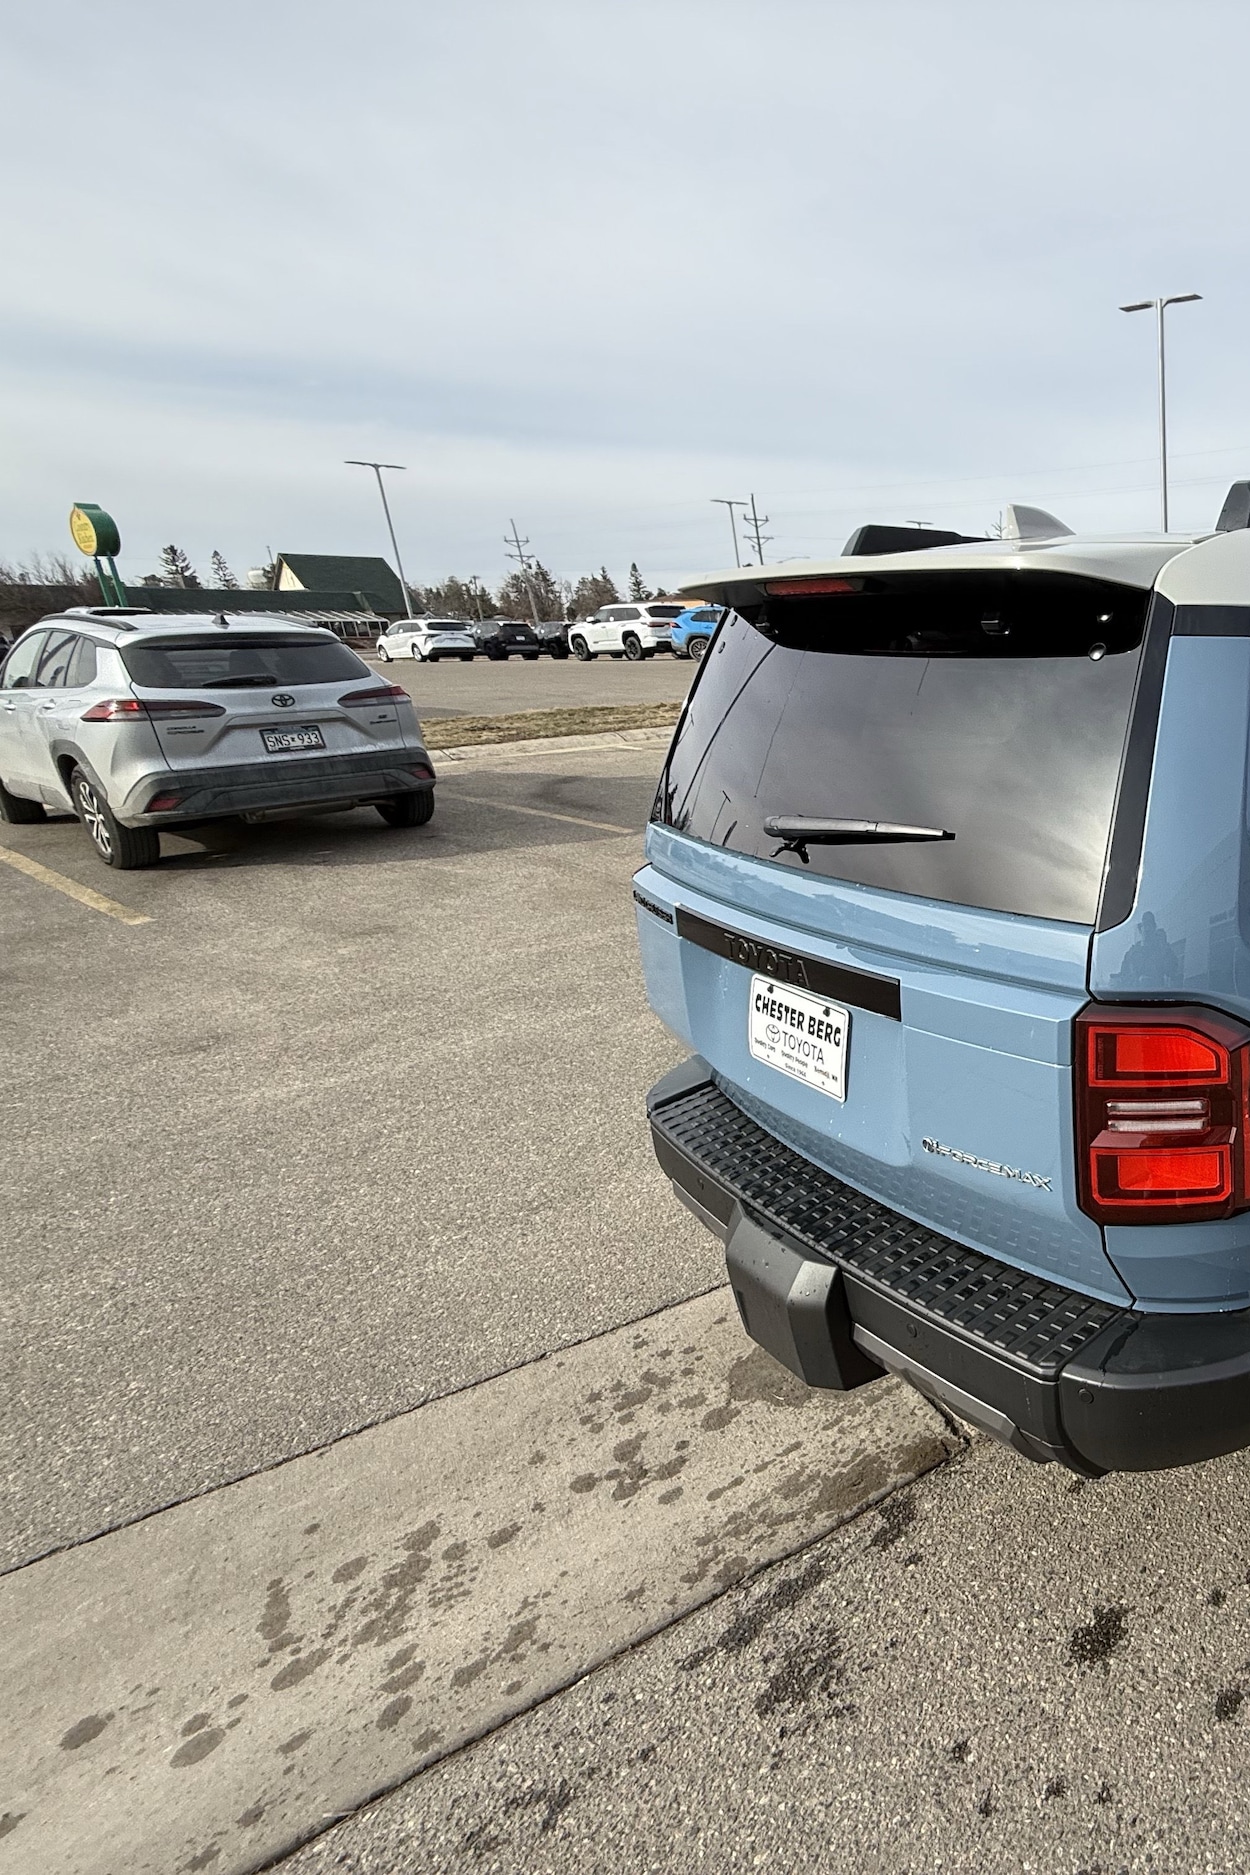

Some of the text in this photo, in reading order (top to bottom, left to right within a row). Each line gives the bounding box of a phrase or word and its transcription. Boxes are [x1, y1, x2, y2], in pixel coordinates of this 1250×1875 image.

[267, 733, 320, 747] SNS 933
[723, 932, 810, 987] TOYOTA
[755, 993, 841, 1047] CHESTER BERG
[782, 1030, 824, 1065] TOYOTA
